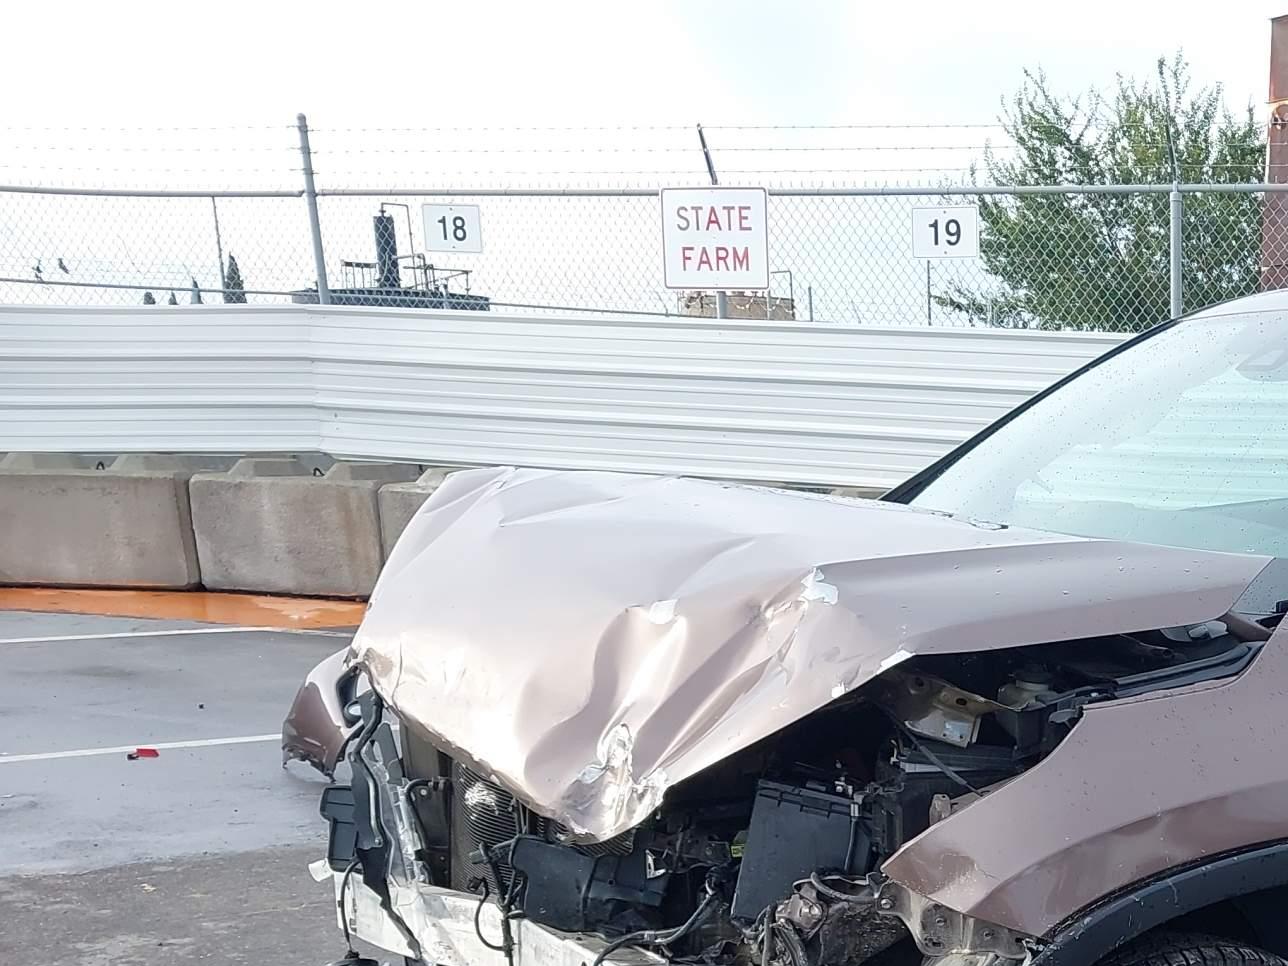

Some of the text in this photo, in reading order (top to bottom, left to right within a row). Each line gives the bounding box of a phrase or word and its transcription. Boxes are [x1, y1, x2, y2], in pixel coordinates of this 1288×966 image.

[437, 215, 467, 242] 18
[676, 205, 753, 232] STATE
[928, 218, 961, 246] 19
[681, 246, 750, 272] FARM
